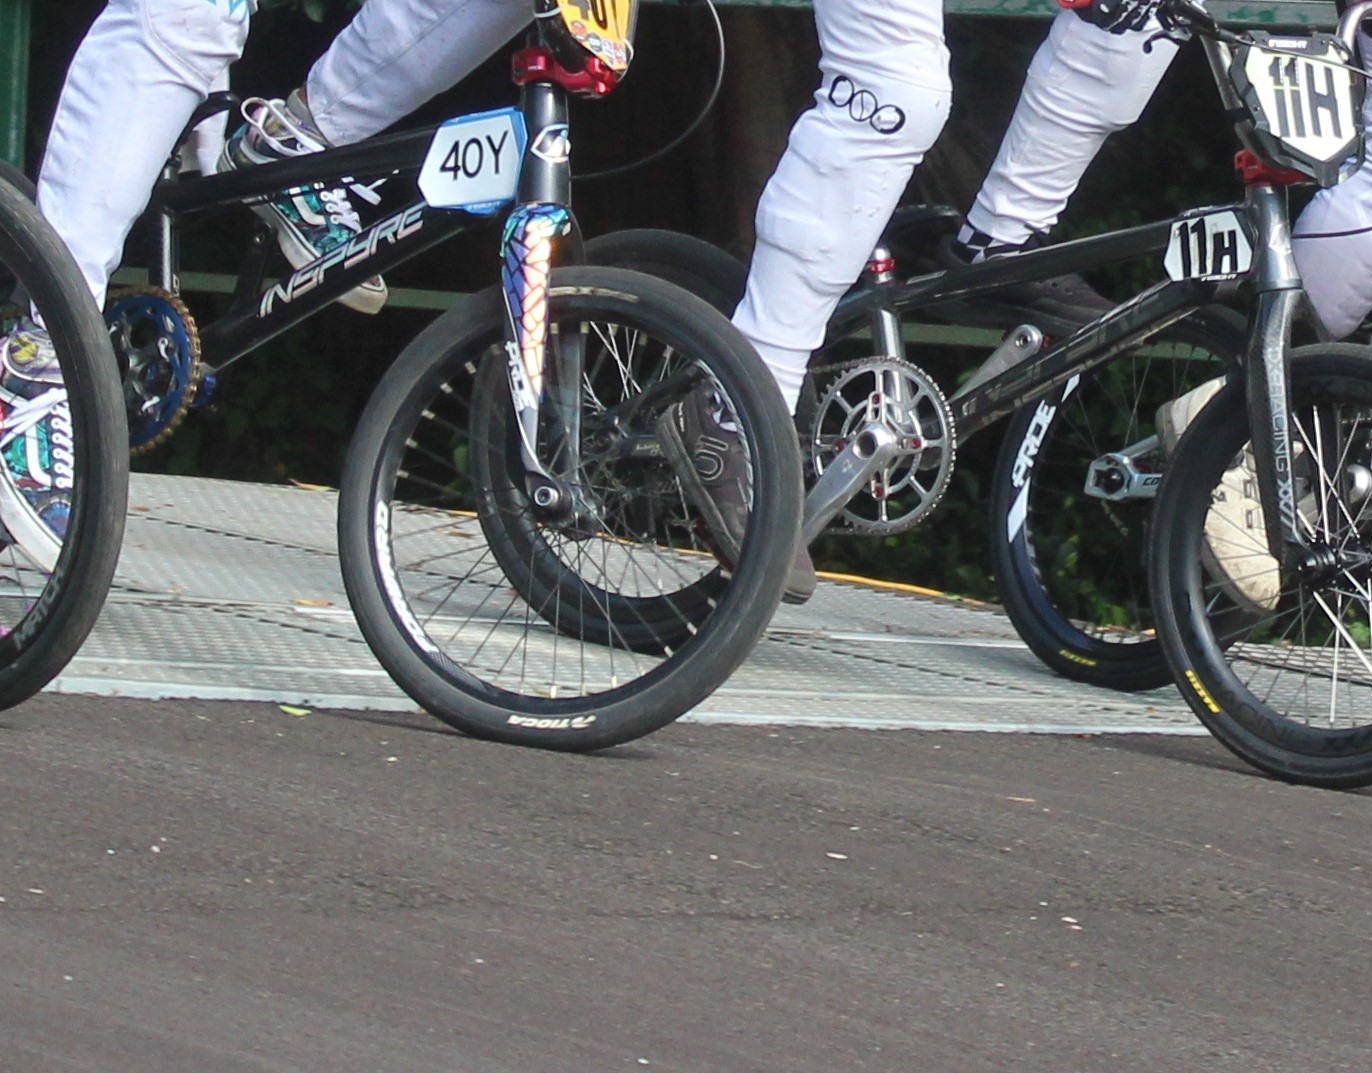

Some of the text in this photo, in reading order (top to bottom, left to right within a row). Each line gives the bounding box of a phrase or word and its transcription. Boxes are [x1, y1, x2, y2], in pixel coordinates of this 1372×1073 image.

[1267, 55, 1343, 139] 11H
[439, 130, 509, 181] 40Y
[1178, 216, 1239, 278] 11H
